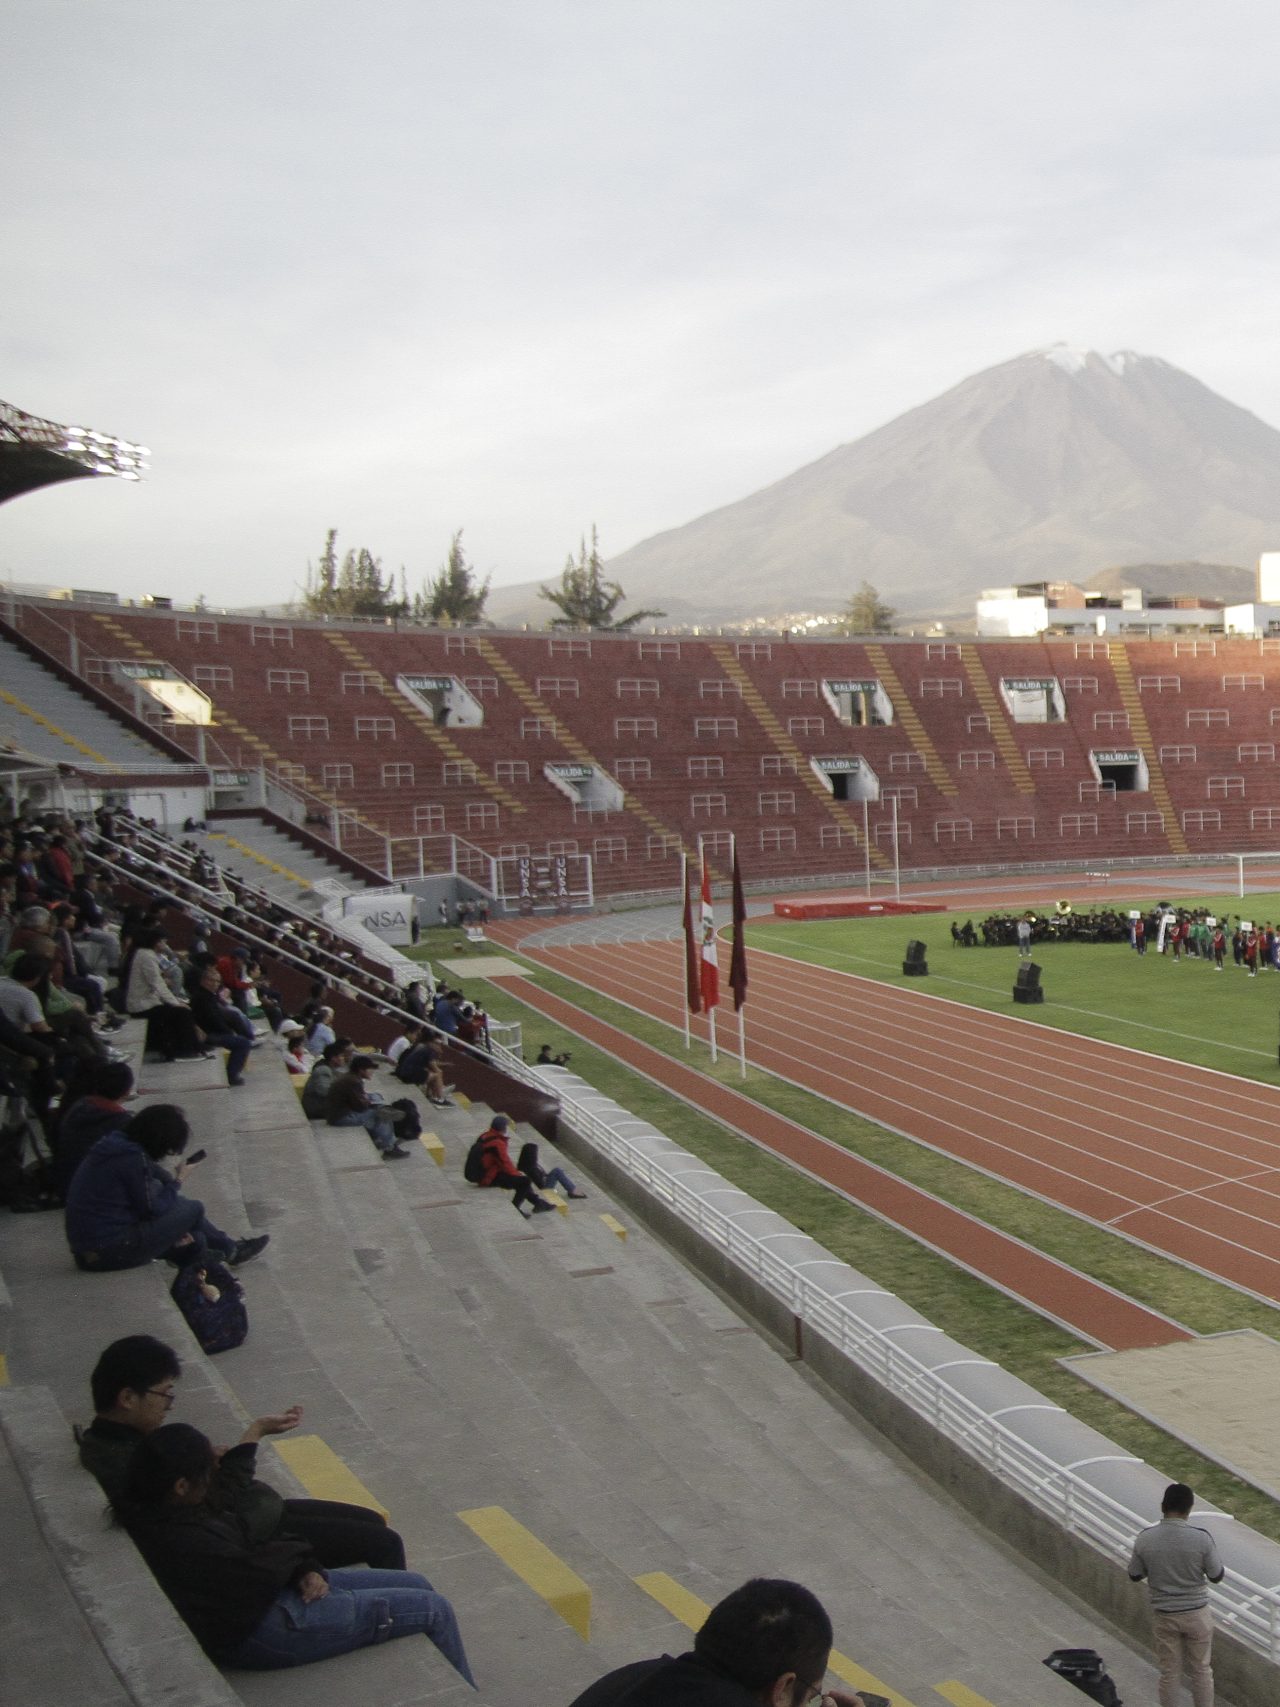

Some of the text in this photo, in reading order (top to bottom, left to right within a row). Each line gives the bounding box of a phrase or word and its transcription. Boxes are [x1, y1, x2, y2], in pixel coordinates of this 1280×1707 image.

[834, 682, 863, 692] SALIDA
[1012, 681, 1041, 689] SALIDA
[1099, 752, 1130, 762] SALIDA
[822, 761, 851, 770] SALIDA
[555, 766, 584, 777] SALIDA
[521, 859, 531, 897] UNSA
[557, 857, 568, 896] UNSA
